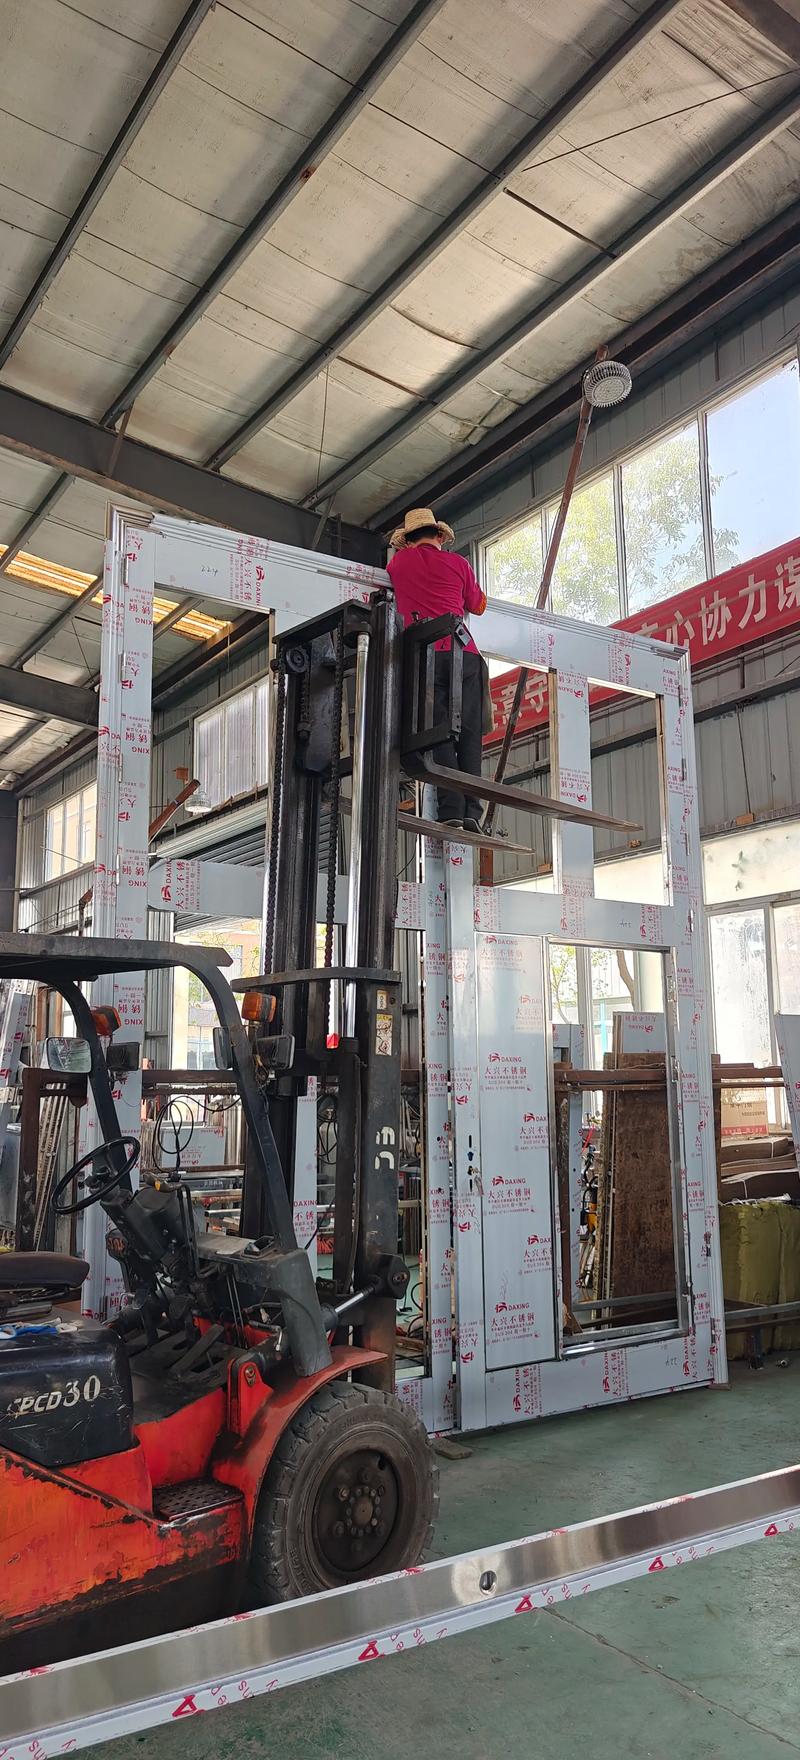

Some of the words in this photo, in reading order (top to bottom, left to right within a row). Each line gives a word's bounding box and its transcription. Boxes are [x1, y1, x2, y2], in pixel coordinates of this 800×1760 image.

[520, 1126, 547, 1135] 大兴不
[523, 1247, 552, 1258] 大兴不
